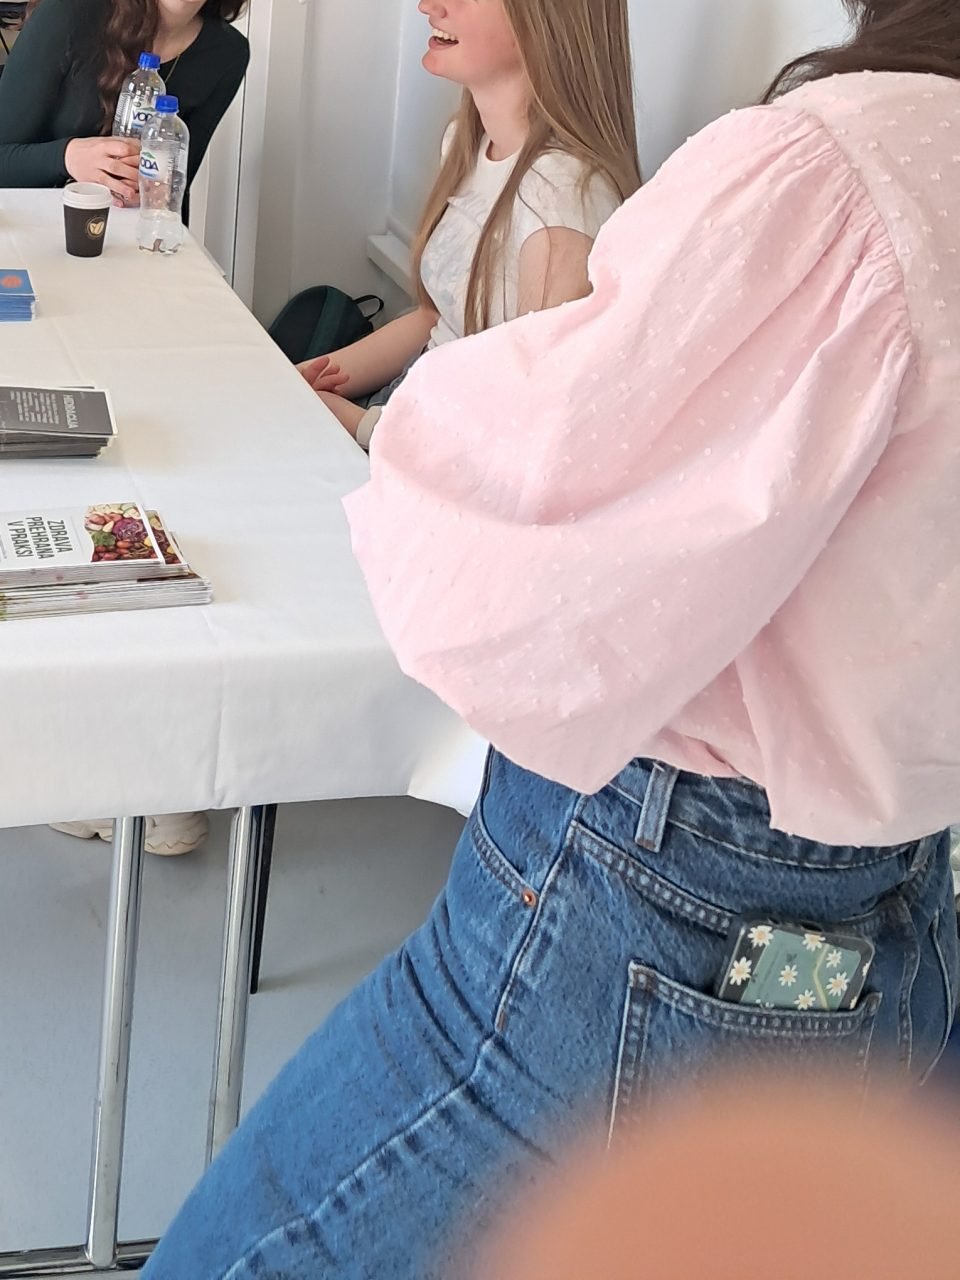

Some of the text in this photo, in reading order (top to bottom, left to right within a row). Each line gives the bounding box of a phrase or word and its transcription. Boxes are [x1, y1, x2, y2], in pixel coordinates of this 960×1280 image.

[9, 527, 34, 558] PRAKSI
[25, 516, 55, 560] PREHRANA
[47, 519, 73, 553] ZDRAVA
